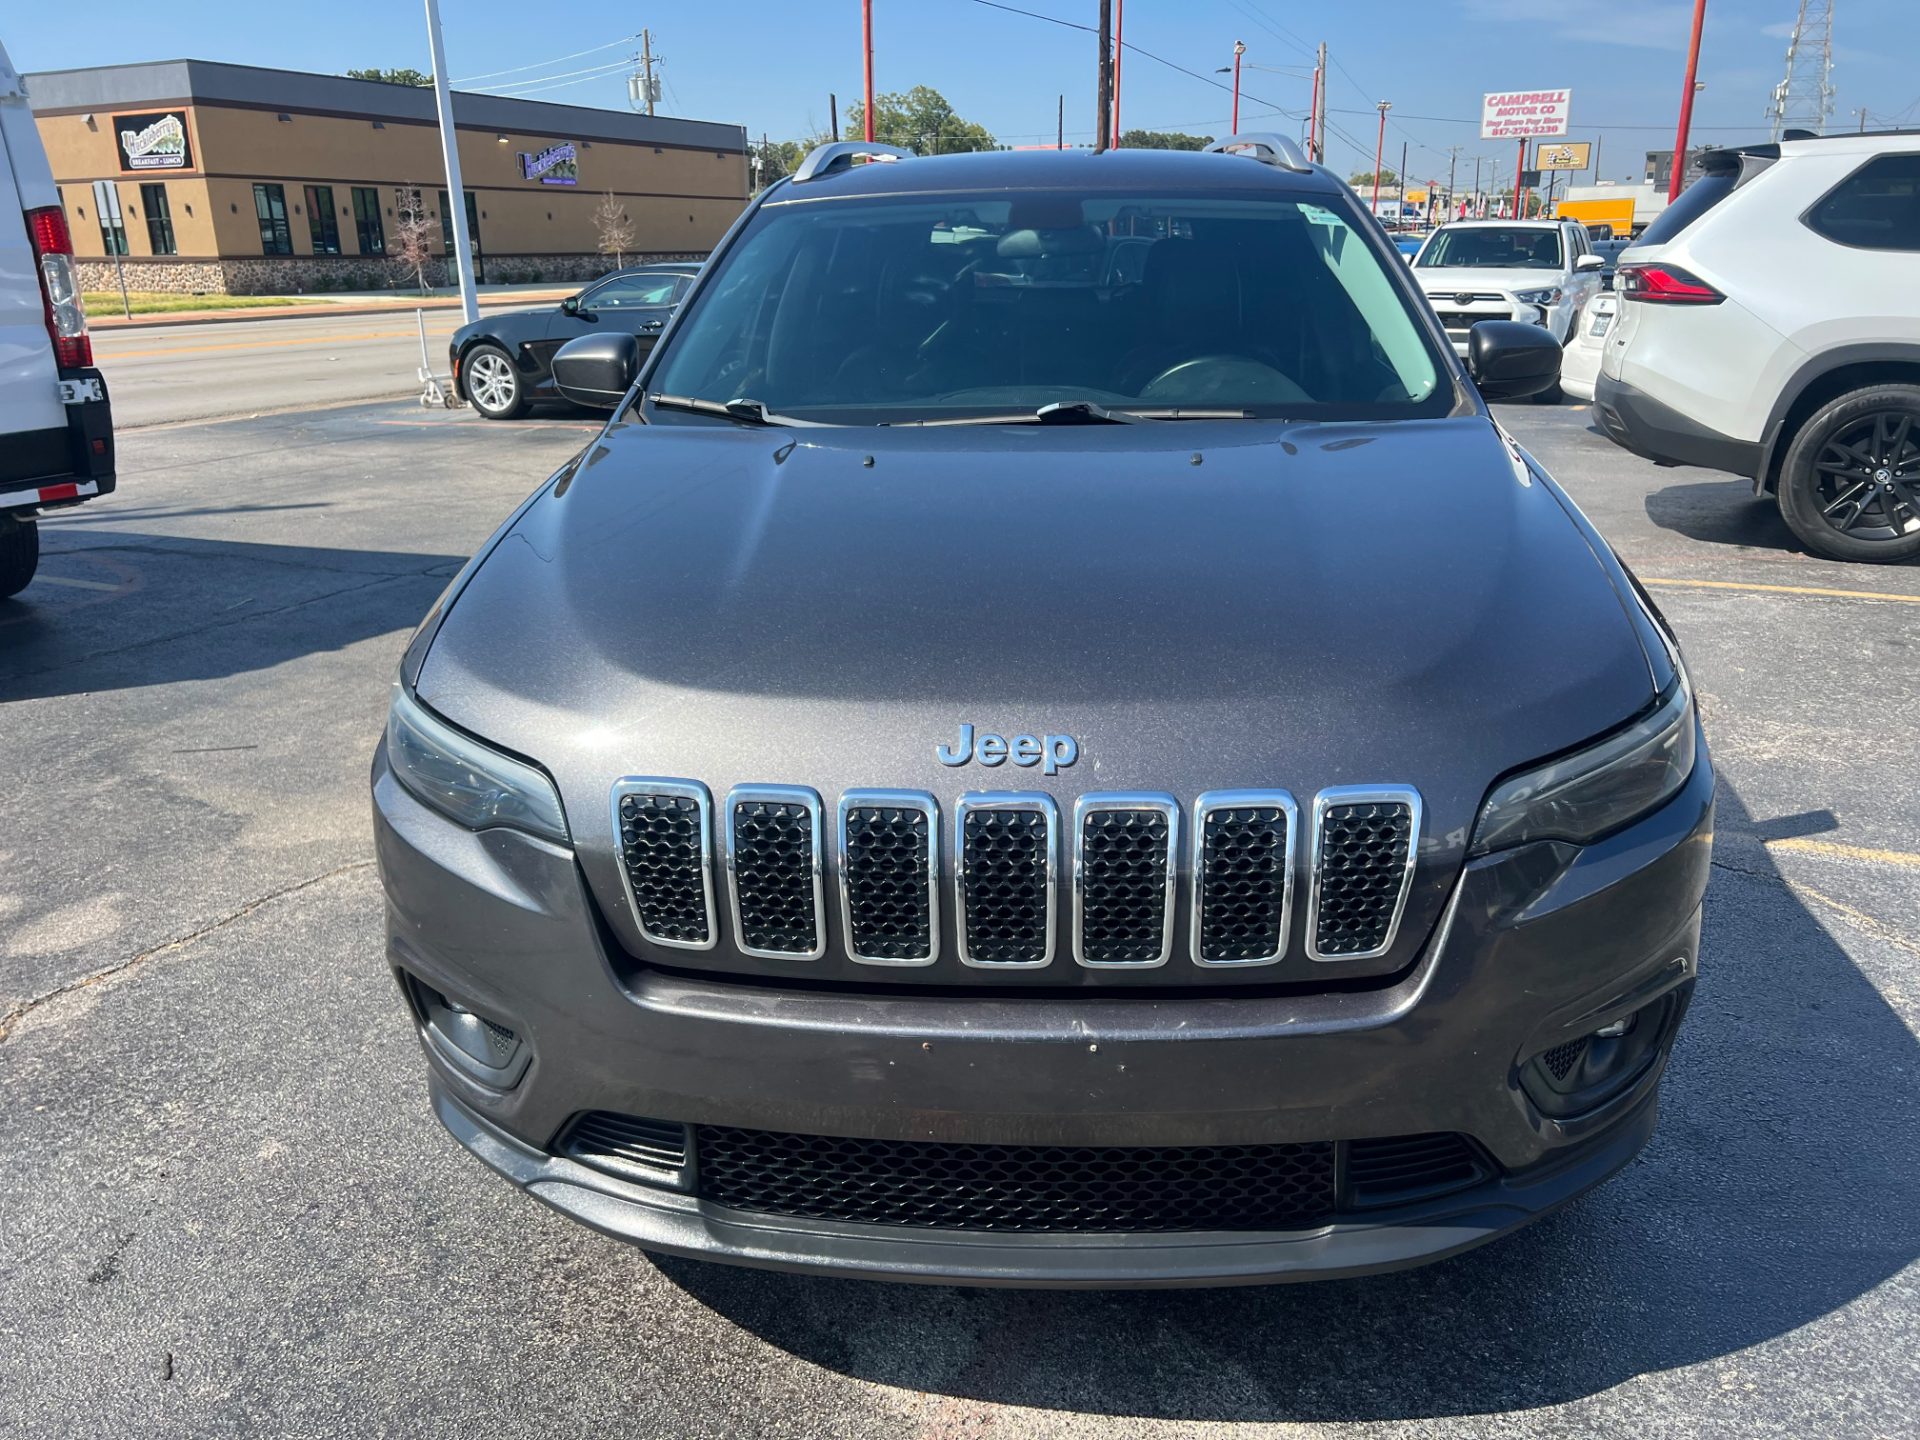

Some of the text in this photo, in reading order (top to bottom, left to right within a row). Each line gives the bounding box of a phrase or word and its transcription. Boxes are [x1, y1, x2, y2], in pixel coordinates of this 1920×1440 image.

[1487, 92, 1566, 107] CAMPBELL
[1496, 105, 1556, 117] MOTOR CO
[936, 723, 1079, 776] Jeep
